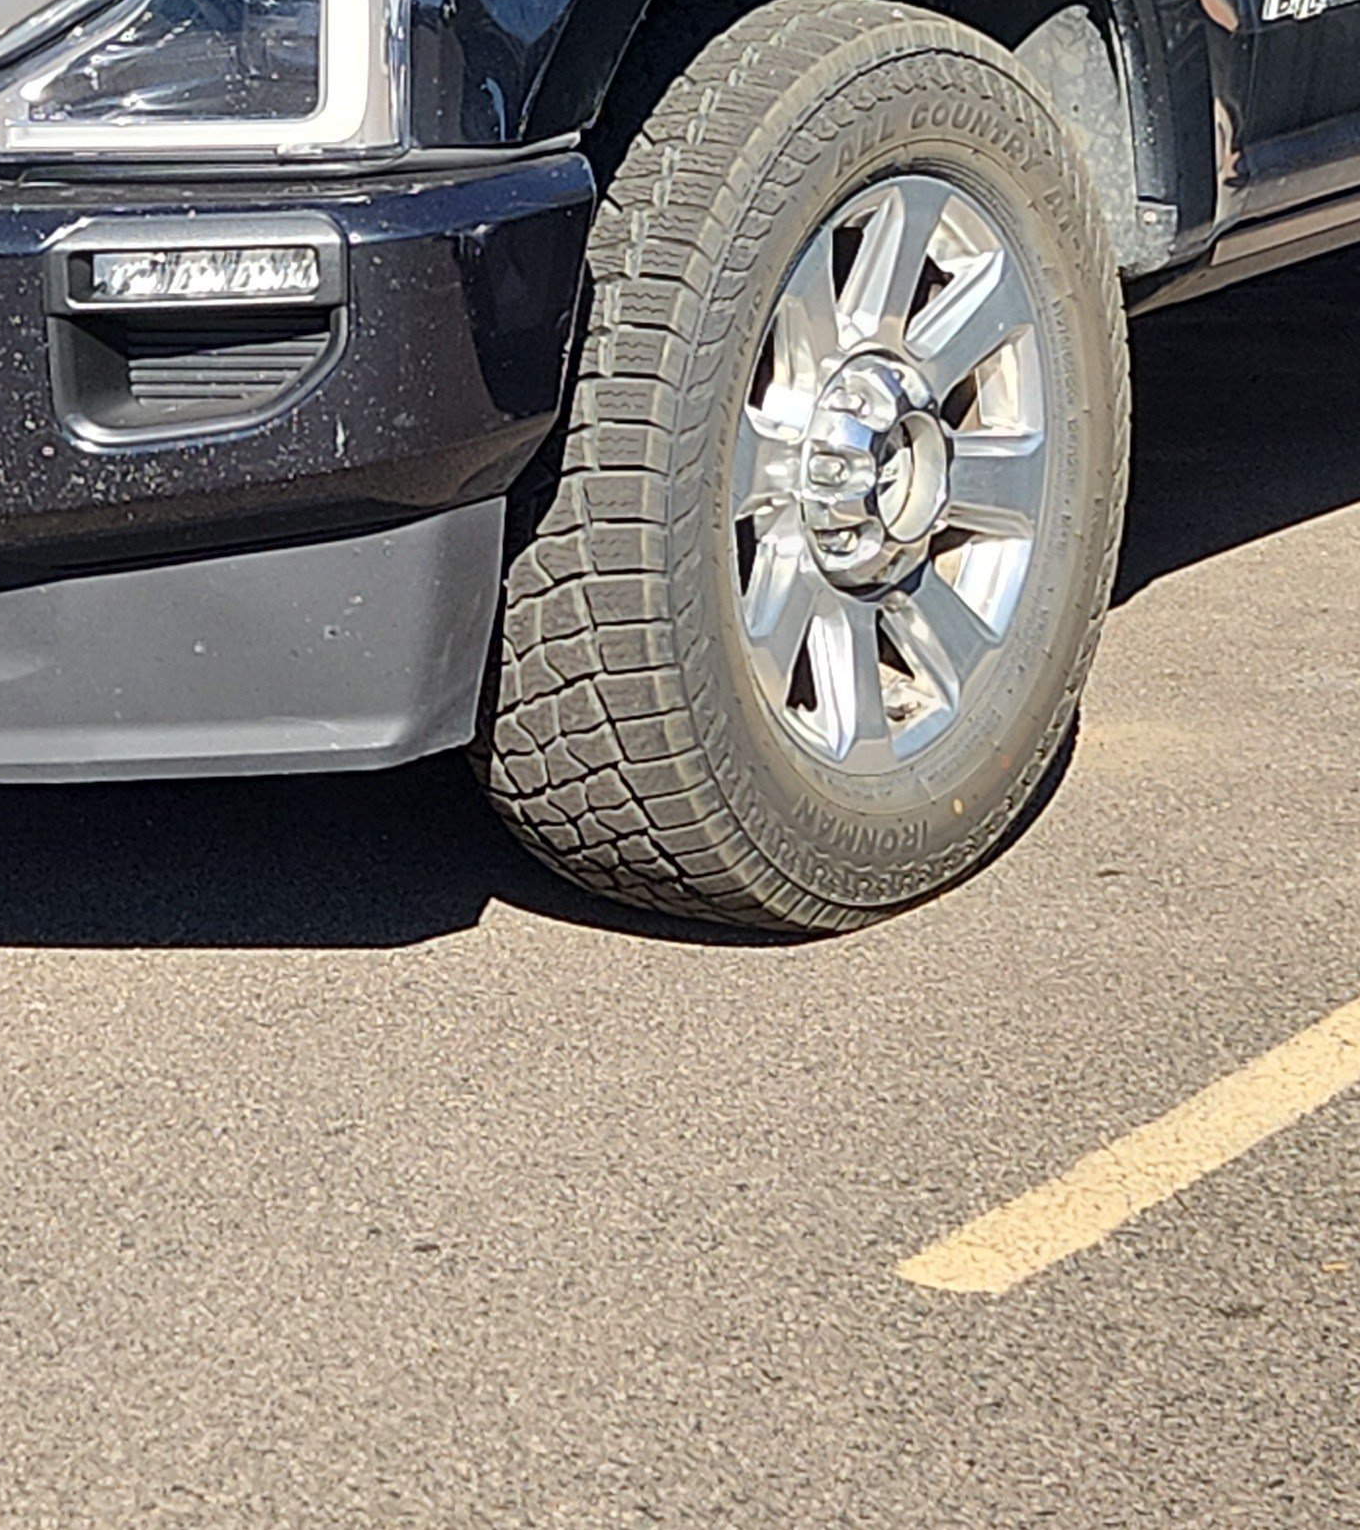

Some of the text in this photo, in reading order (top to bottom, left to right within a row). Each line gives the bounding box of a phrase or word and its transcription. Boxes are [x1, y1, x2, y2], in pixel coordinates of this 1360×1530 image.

[835, 117, 897, 177] ALL
[910, 101, 1043, 172] COUNTRY
[791, 794, 927, 855] IRONMAN
